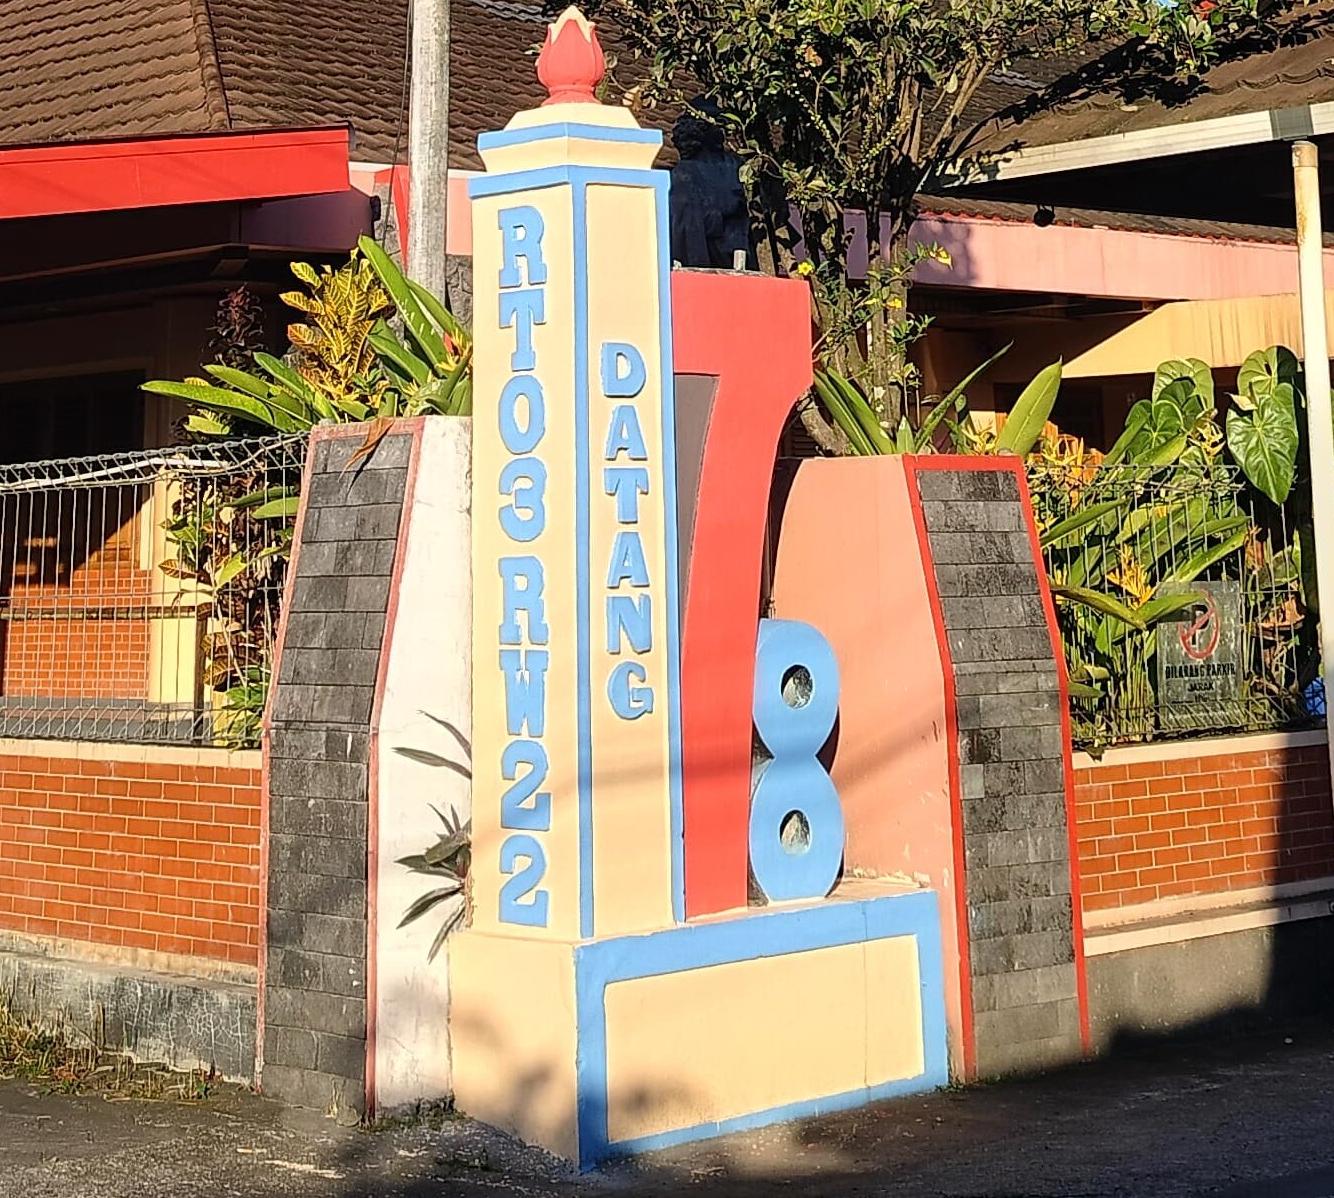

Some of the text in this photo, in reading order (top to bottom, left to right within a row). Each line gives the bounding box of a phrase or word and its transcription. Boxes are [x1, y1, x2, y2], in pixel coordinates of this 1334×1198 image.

[600, 341, 655, 721] DATANG
[1165, 662, 1236, 679] DILARANG PARKIR
